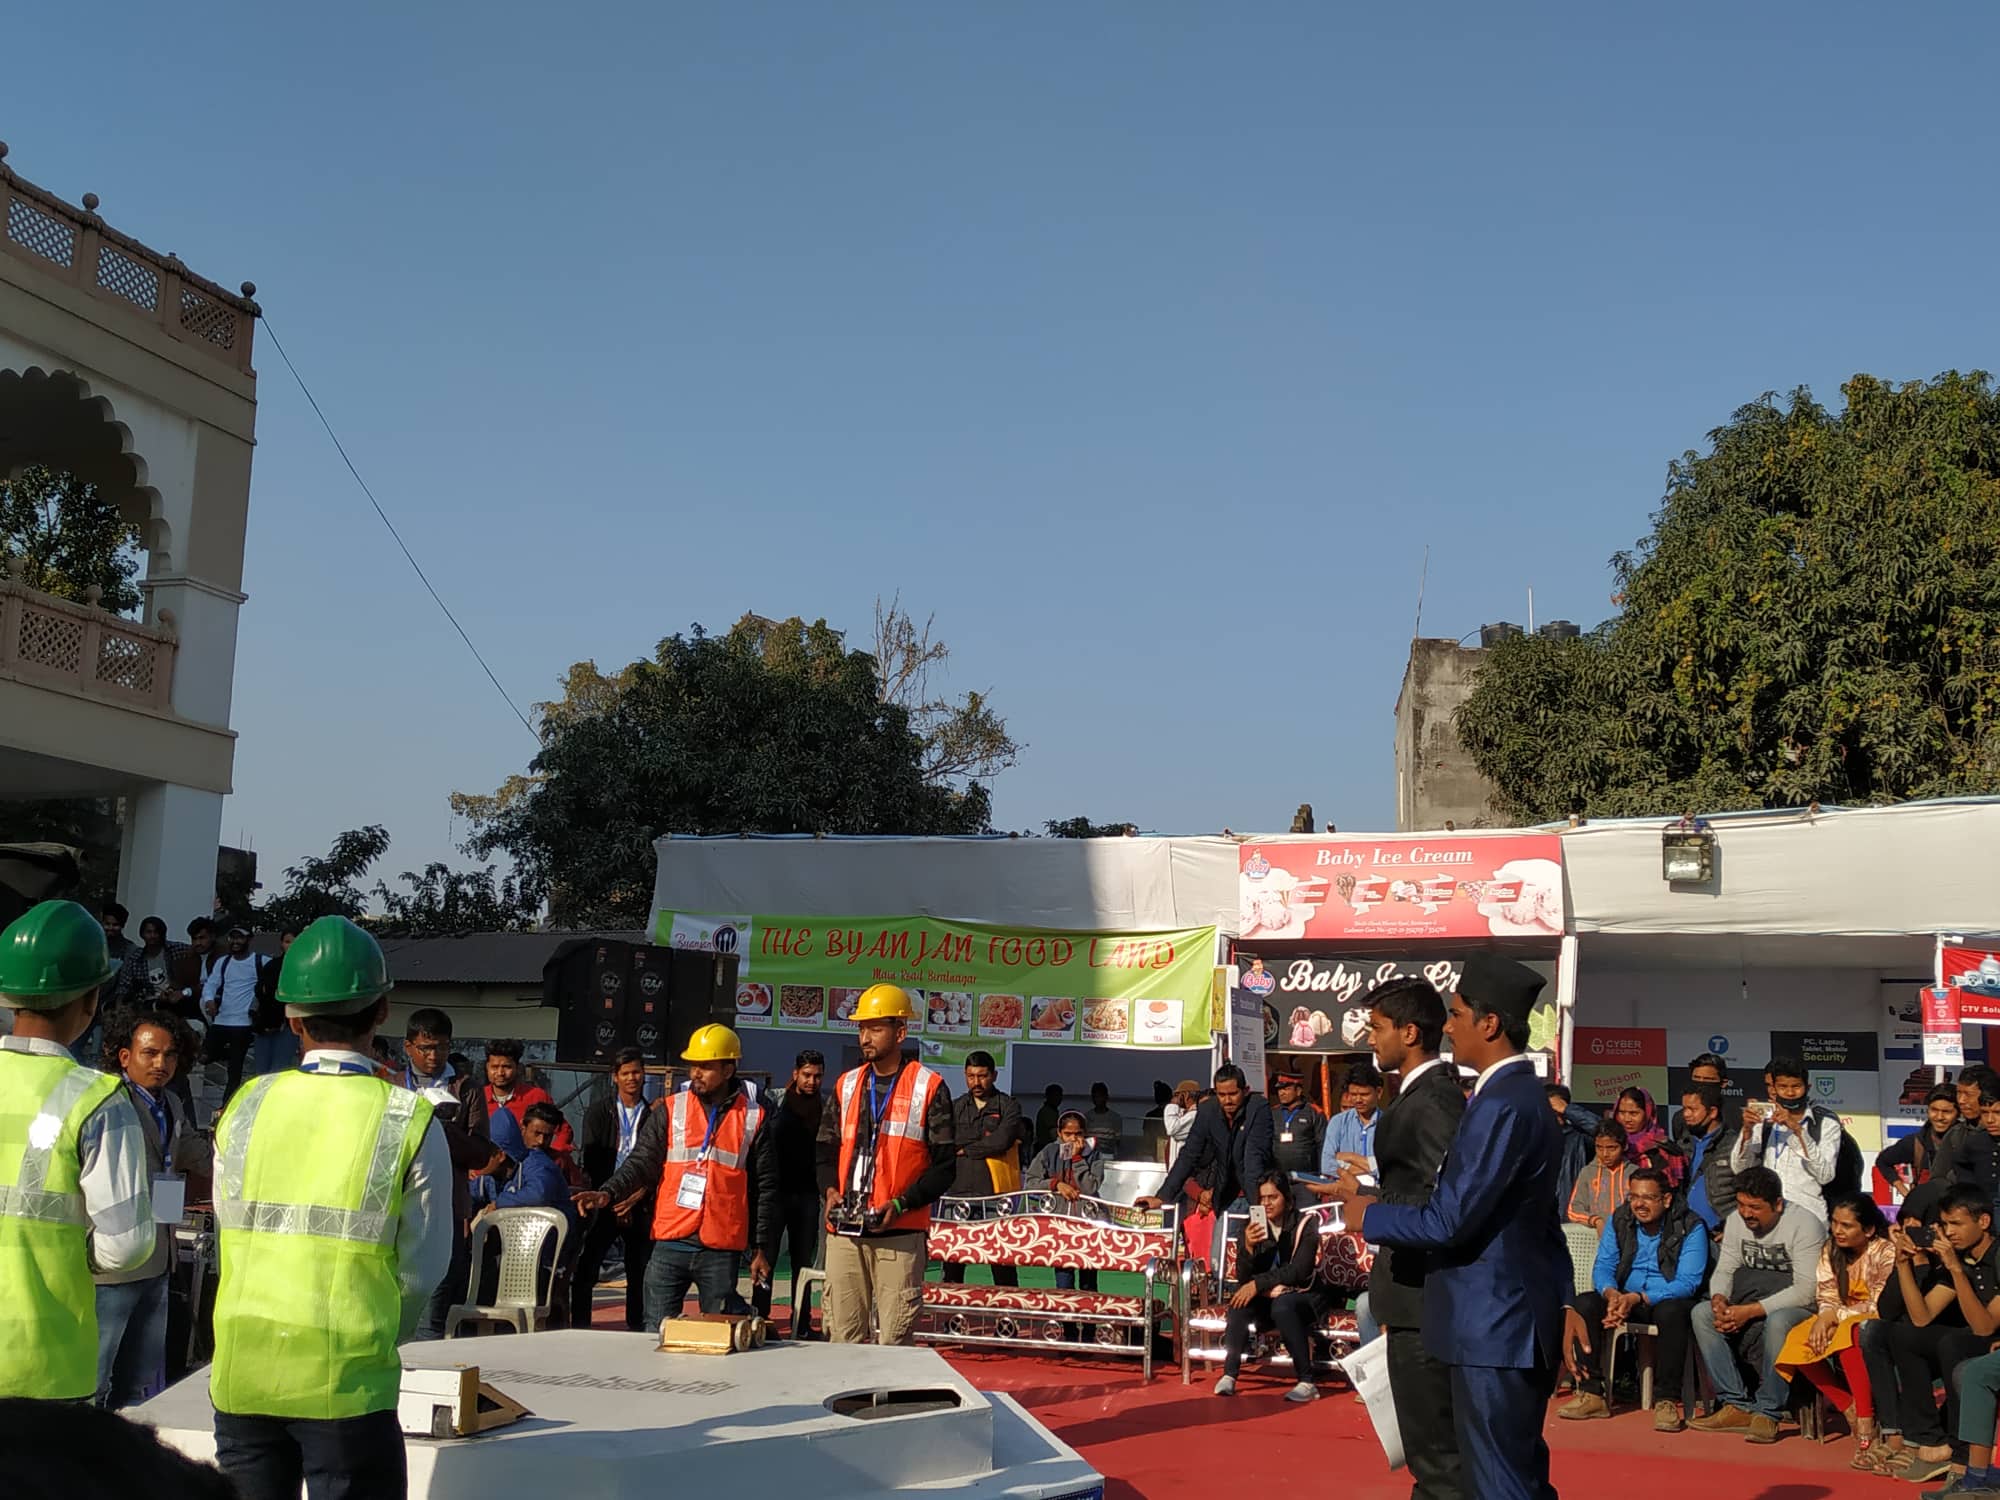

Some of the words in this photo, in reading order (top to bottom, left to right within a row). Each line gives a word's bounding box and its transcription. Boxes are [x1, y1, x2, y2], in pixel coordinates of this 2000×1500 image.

[1315, 848, 1366, 869] Baby
[1372, 847, 1403, 866] Ice
[1409, 846, 1474, 865] Cream
[761, 927, 814, 957] THE
[824, 928, 977, 968] BYANJAN
[988, 936, 1075, 966] FOOD
[1087, 936, 1176, 970] LAND
[872, 967, 897, 980] Main
[1243, 973, 1274, 988] Baby
[1280, 959, 1363, 1003] Baby
[1606, 1039, 1642, 1049] CYBER
[1818, 1039, 1846, 1047] Laptop
[1802, 1052, 1847, 1063] Security
[1594, 1071, 1641, 1088] Ransom
